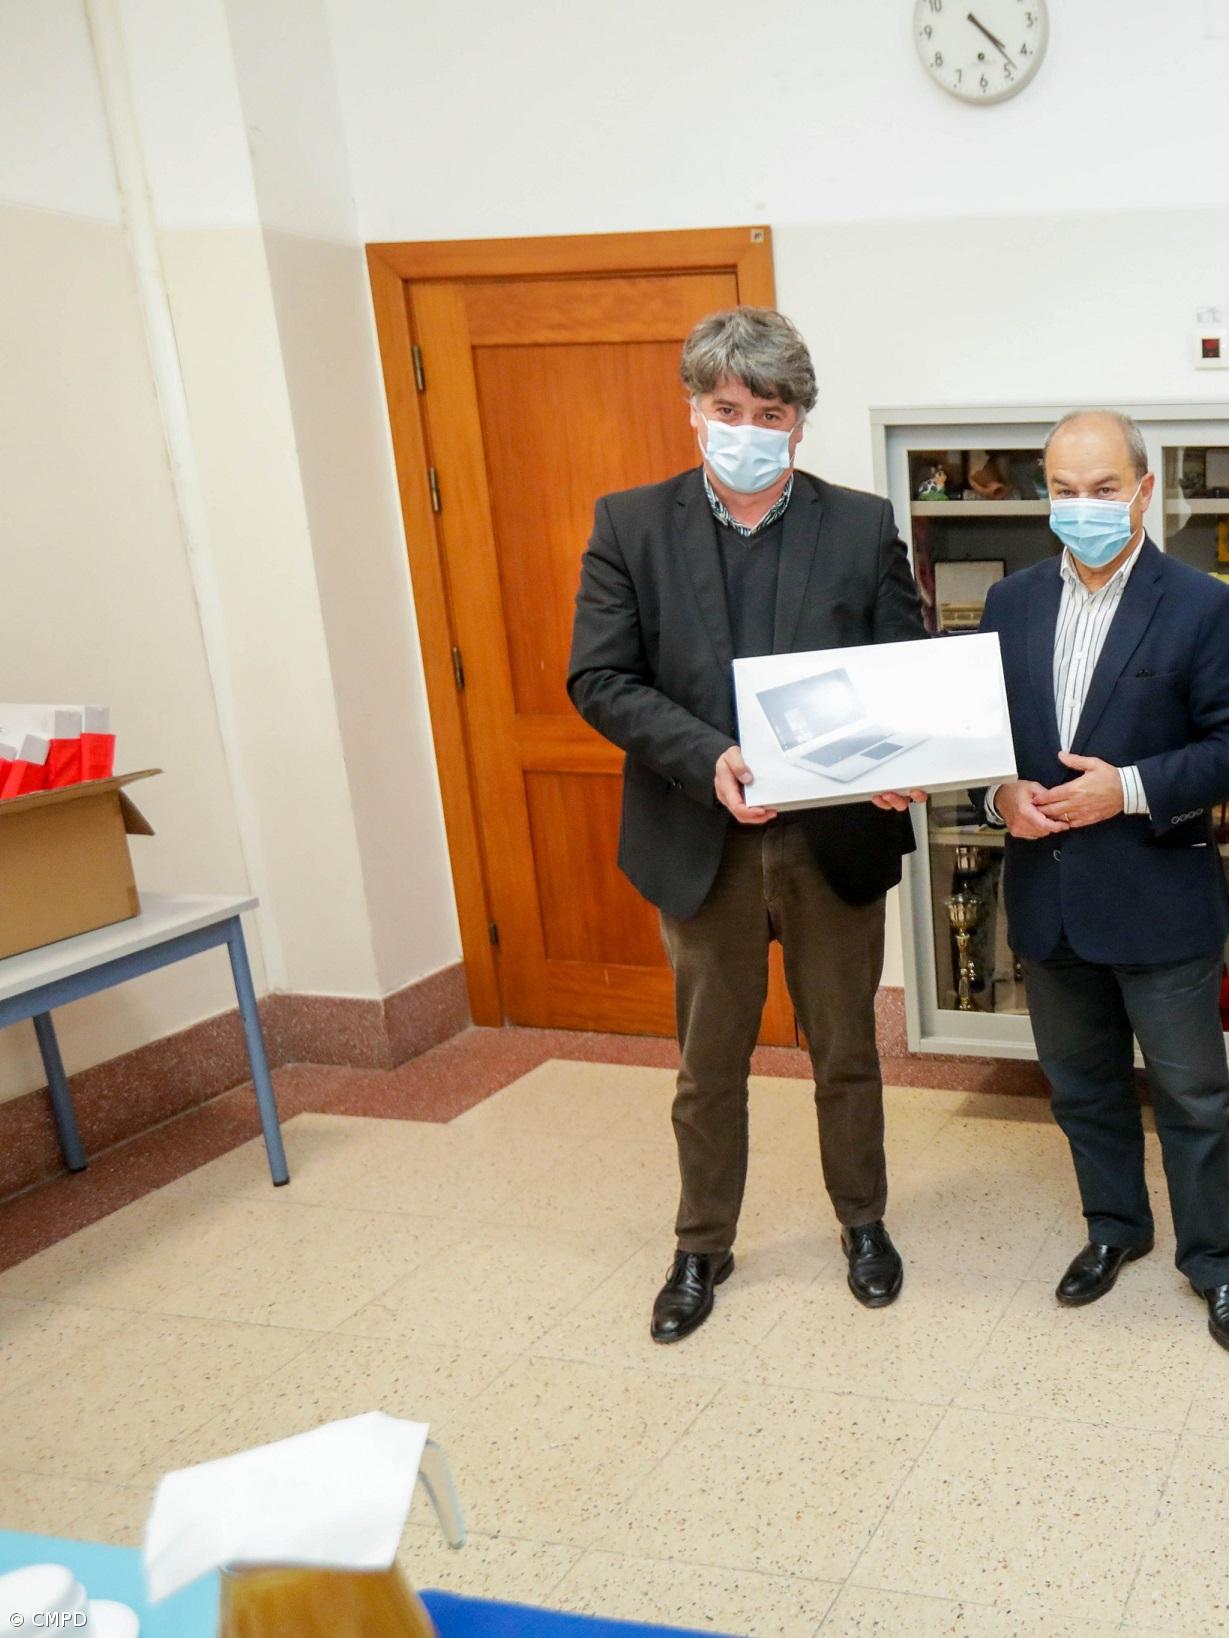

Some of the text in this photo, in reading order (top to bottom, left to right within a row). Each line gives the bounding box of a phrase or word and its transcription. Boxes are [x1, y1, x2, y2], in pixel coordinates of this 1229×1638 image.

[1026, 12, 1034, 28] 3
[924, 25, 932, 40] 9
[1020, 43, 1028, 55] 4
[935, 51, 943, 67] 8
[955, 69, 962, 84] 7
[1004, 63, 1012, 79] 5
[980, 74, 988, 88] 6
